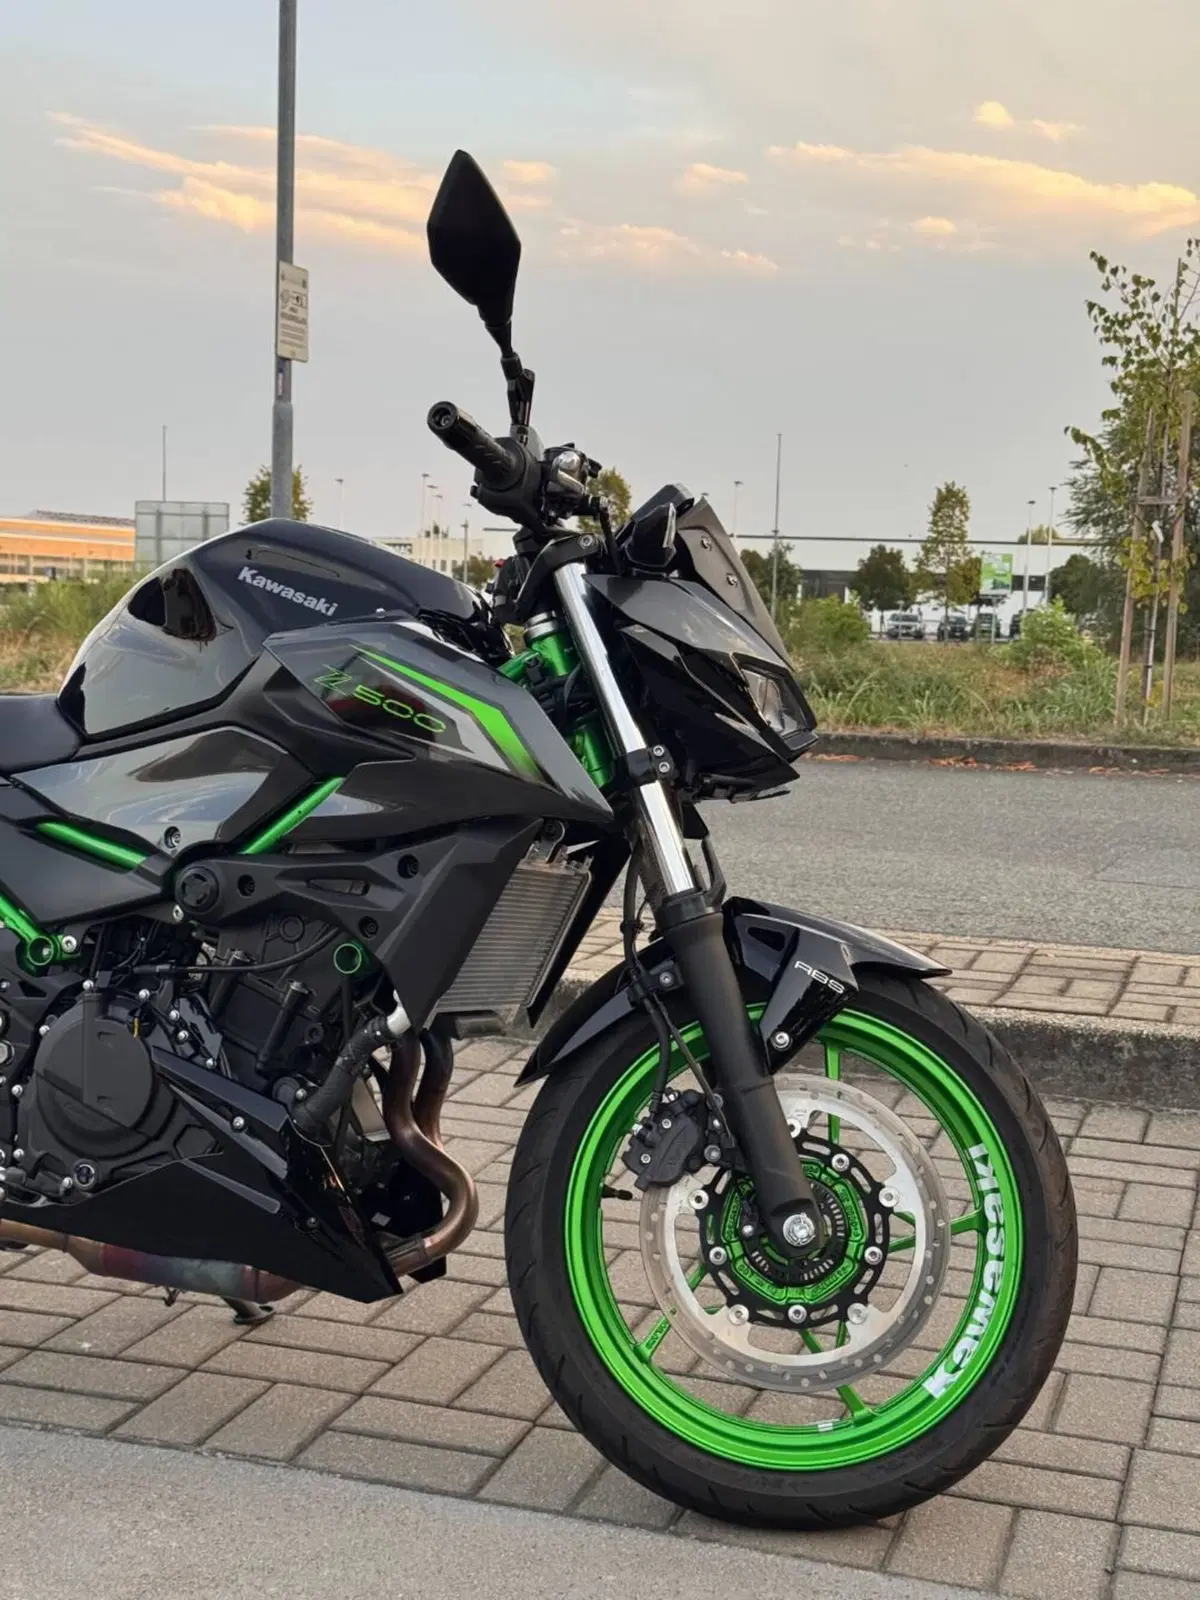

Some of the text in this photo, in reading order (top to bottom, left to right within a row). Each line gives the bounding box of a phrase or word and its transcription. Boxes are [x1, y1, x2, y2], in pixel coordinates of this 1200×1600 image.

[237, 566, 339, 617] Kawasaki
[793, 960, 845, 994] ABS
[921, 1142, 1005, 1400] Kawasaki
